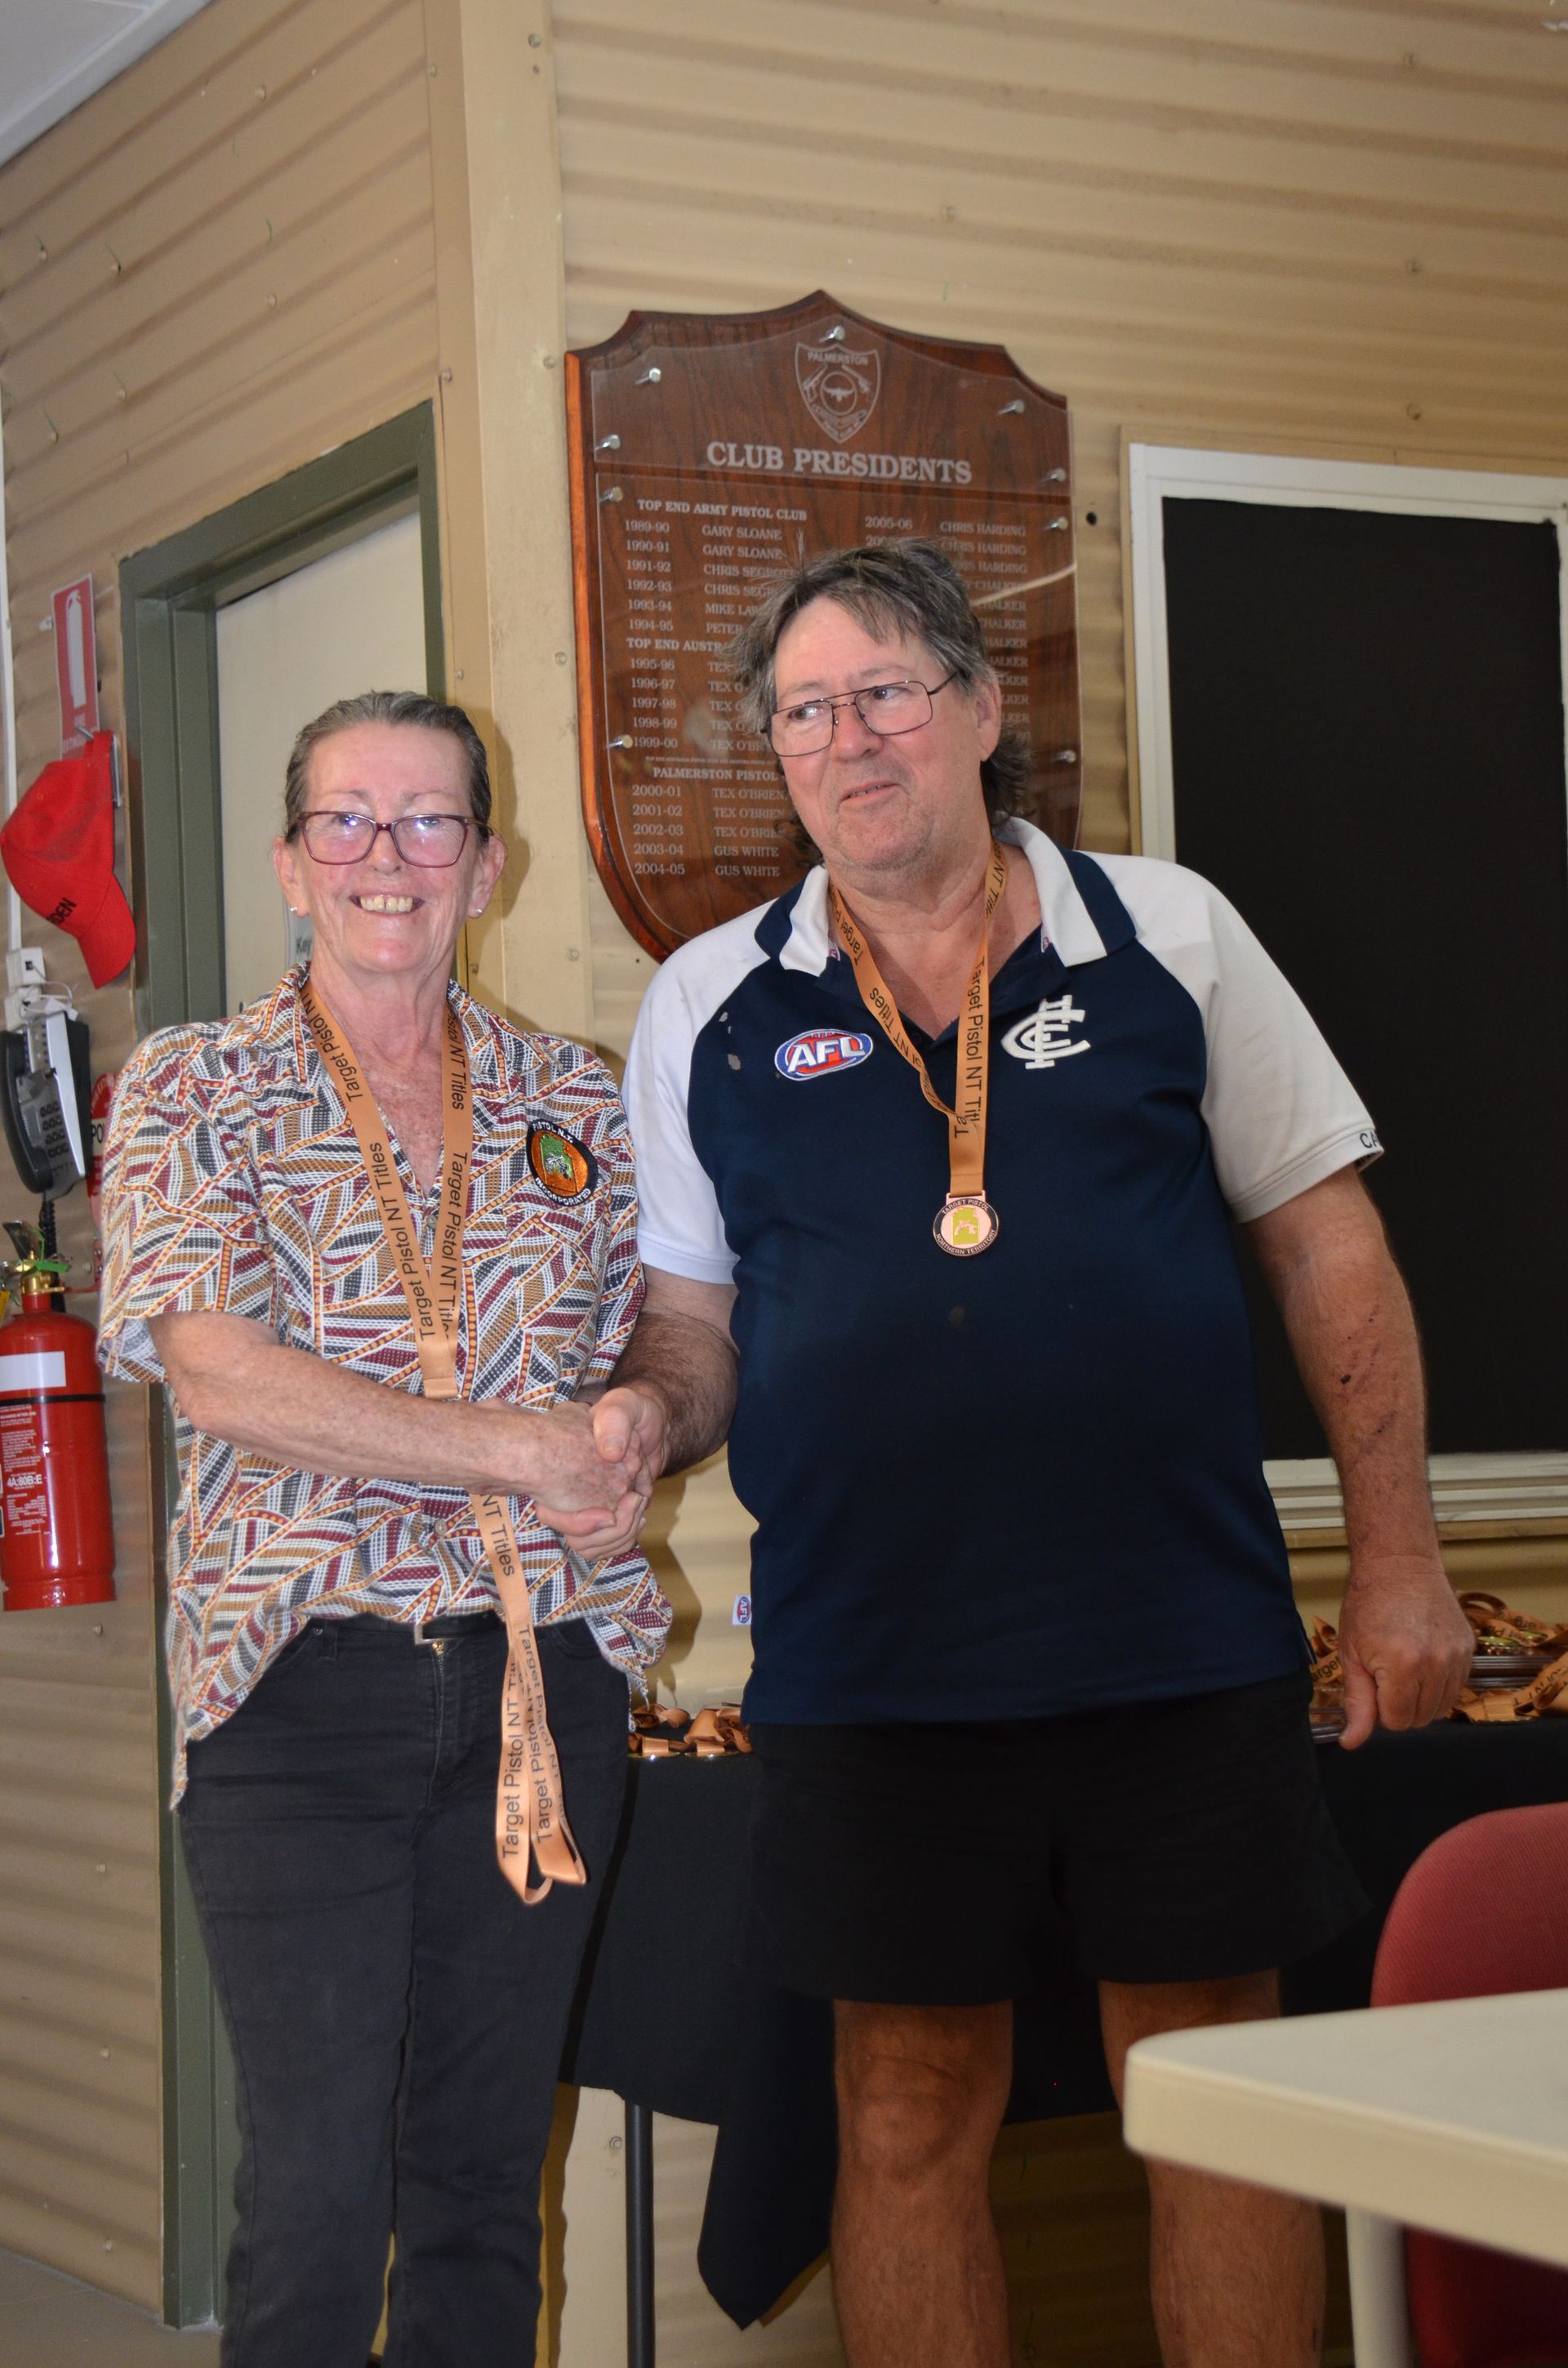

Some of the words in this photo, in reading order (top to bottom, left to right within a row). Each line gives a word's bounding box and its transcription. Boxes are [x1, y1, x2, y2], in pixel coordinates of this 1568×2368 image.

[707, 442, 783, 470] CLUB
[793, 448, 972, 484] PRESIDENTS
[637, 499, 662, 511] TOP
[665, 501, 690, 513] END
[693, 503, 728, 516] ARMY
[731, 506, 773, 519] PISTOL
[777, 508, 807, 521] CLUB
[702, 525, 733, 538] GARY
[737, 527, 782, 540] SLOANE
[940, 520, 973, 535] CHRIS
[977, 523, 1027, 537] HARDING
[626, 540, 670, 553] 1990-91
[702, 544, 733, 557] GARY
[737, 546, 782, 560] SLOANE
[978, 542, 1027, 556] HARDING
[626, 560, 670, 573] 1991-92
[703, 564, 739, 577] CHRIS
[978, 562, 1027, 575] HARDING
[627, 579, 671, 592] 1992-93
[704, 583, 740, 596] CHRIS
[628, 599, 671, 612] 1993-94
[706, 603, 735, 616] MIKE
[630, 619, 674, 632] 1994-95
[706, 622, 742, 635] PETER
[626, 638, 651, 650] TOP
[655, 639, 679, 652] END
[630, 658, 675, 671] 1995-96
[631, 676, 675, 690] 1996-97
[707, 680, 732, 693] TEX
[632, 697, 676, 709] 1997-98
[709, 700, 733, 713] TEX
[633, 716, 677, 729] 1998-99
[710, 720, 733, 732] TEX
[710, 739, 733, 751] TEX
[653, 767, 733, 780] PALMERSTON
[736, 769, 778, 783] PISTOL
[632, 785, 681, 797] 2000-01
[711, 787, 736, 800] TEX
[738, 788, 784, 801] O'BRIEN
[633, 805, 682, 817] 2001-02
[713, 806, 737, 818] TEX
[634, 824, 684, 836] 2002-03
[714, 826, 737, 838] TEX
[635, 844, 684, 856] 2003-04
[714, 846, 739, 858] GUS
[742, 846, 779, 858] WHITE
[635, 863, 685, 876] 2004-05
[715, 866, 740, 877] GUS
[742, 866, 780, 877] WHITE
[967, 956, 984, 1011] Target
[870, 988, 894, 1034] Titles
[310, 1014, 336, 1054] Pistol
[966, 1014, 983, 1061] Pistol
[450, 1045, 465, 1068] NT
[786, 1034, 866, 1073] AFL
[333, 1051, 363, 1103] Target
[965, 1066, 982, 1091] NT
[452, 1072, 467, 1110] Titles
[964, 1095, 982, 1122] Titl
[370, 1142, 393, 1192] Titles
[447, 1152, 468, 1208] Target
[381, 1195, 400, 1223] NT
[942, 1199, 966, 1215] TARGET
[968, 1199, 991, 1212] PISTOL
[441, 1211, 461, 1262] Pistol
[935, 1233, 964, 1255] NORTHERN
[390, 1228, 418, 1278] Pistol
[439, 1265, 457, 1290] NT
[408, 1279, 435, 1340] Target
[491, 1523, 514, 1576] Titles
[519, 1624, 541, 1688] Target
[506, 1697, 522, 1726] NT
[527, 1719, 545, 1773] Pistol
[503, 1734, 523, 1787] Pistol
[534, 1777, 553, 1844] Target
[502, 1794, 524, 1858] Target
